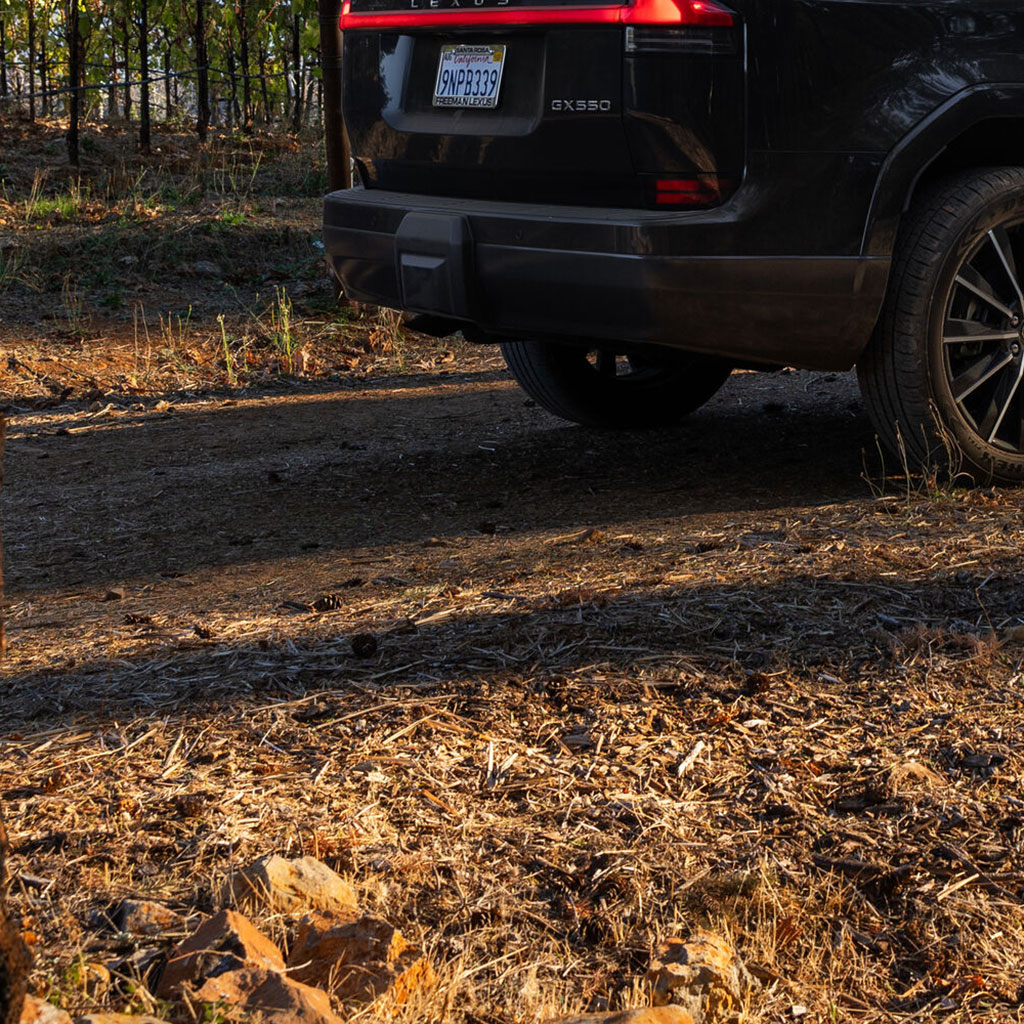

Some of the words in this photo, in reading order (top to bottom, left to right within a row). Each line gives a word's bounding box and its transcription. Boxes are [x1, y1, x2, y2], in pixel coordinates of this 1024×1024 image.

[454, 55, 493, 68] California
[440, 69, 498, 96] 9NPB339
[436, 97, 467, 105] FREEMAN
[469, 97, 492, 106] LEXUS
[551, 98, 612, 112] GX550
